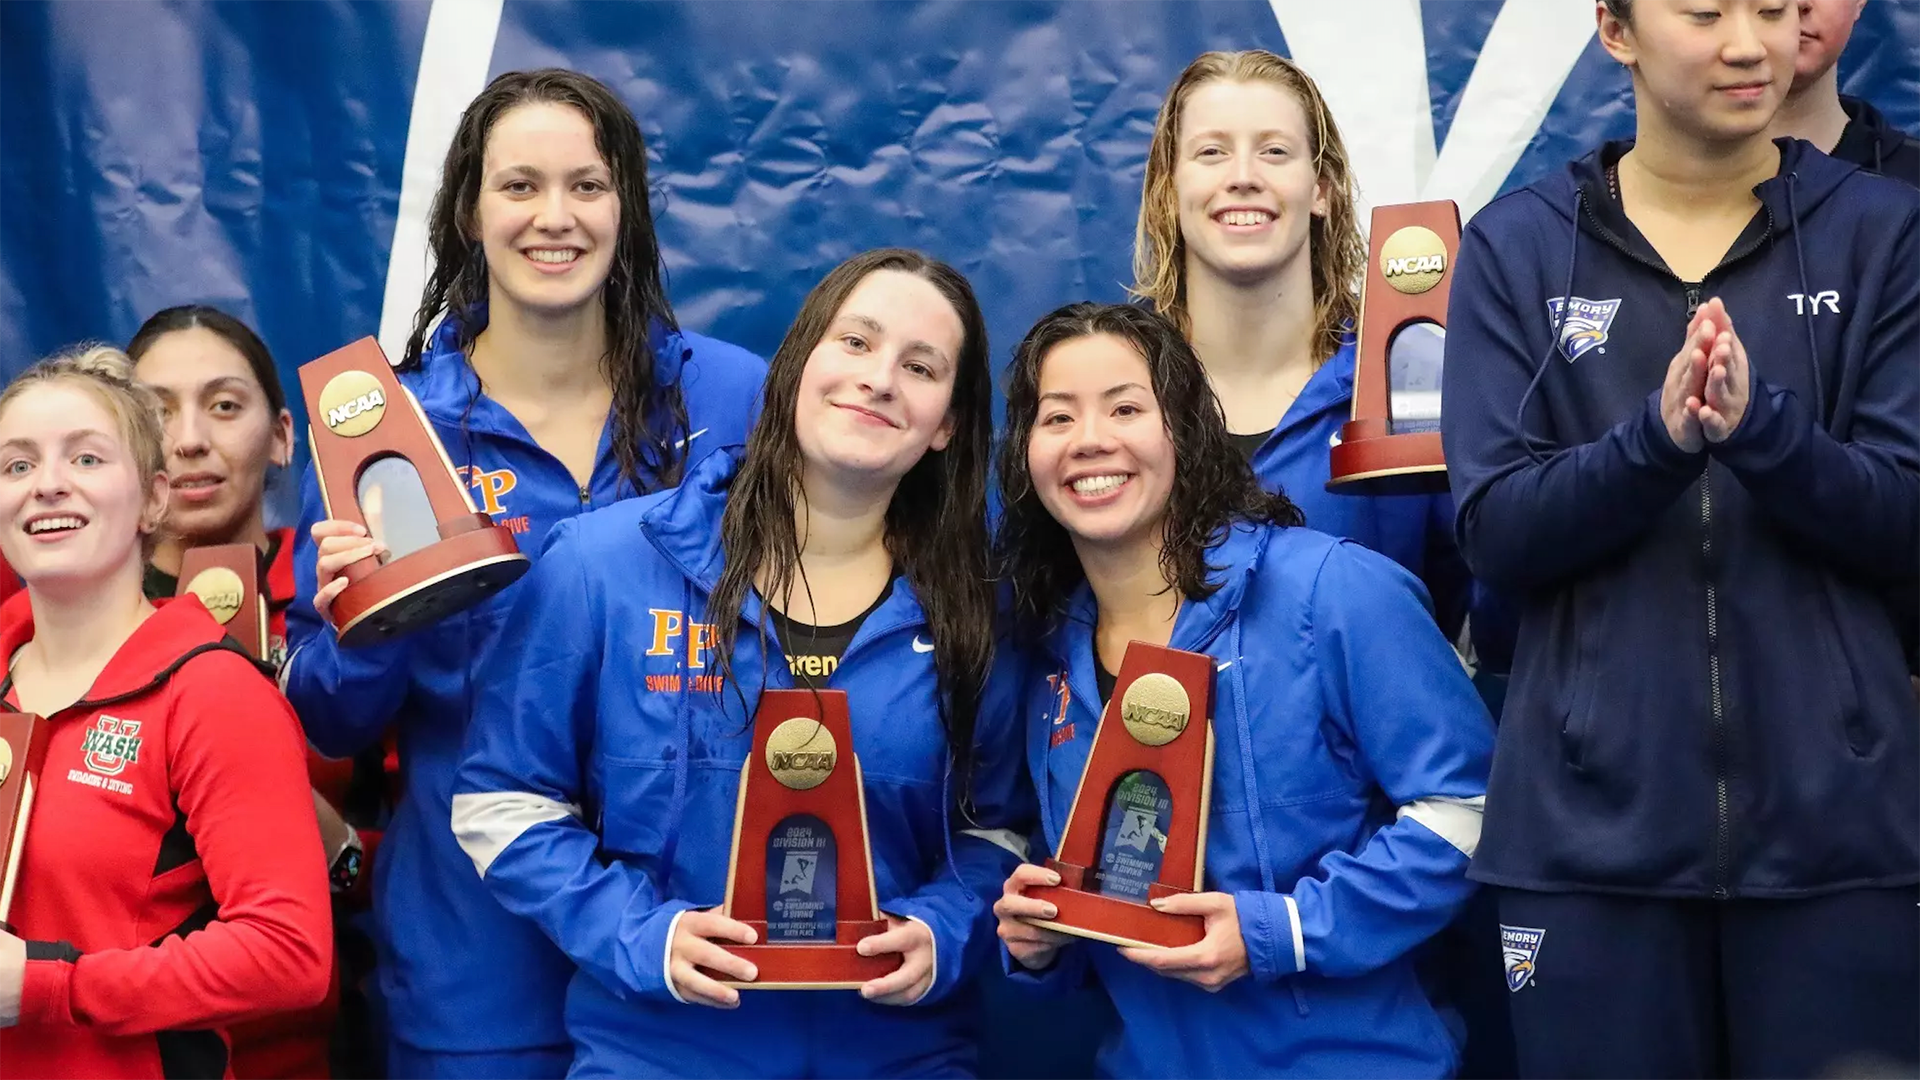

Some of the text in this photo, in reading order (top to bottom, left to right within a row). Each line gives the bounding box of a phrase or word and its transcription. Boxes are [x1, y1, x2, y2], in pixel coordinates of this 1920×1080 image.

[1386, 254, 1444, 277] NCAA
[1555, 301, 1613, 315] EMORY
[1787, 290, 1841, 316] TYR
[328, 389, 385, 428] NCAA
[785, 654, 839, 676] ren
[646, 675, 681, 692] SWIM
[1124, 701, 1185, 731] NCAA
[81, 727, 142, 764] WASH
[771, 750, 833, 770] NCAA
[1117, 790, 1157, 807] DIVISION
[786, 827, 812, 837] 2024
[773, 837, 814, 848] DIVISION
[1503, 931, 1539, 944] EMORY
